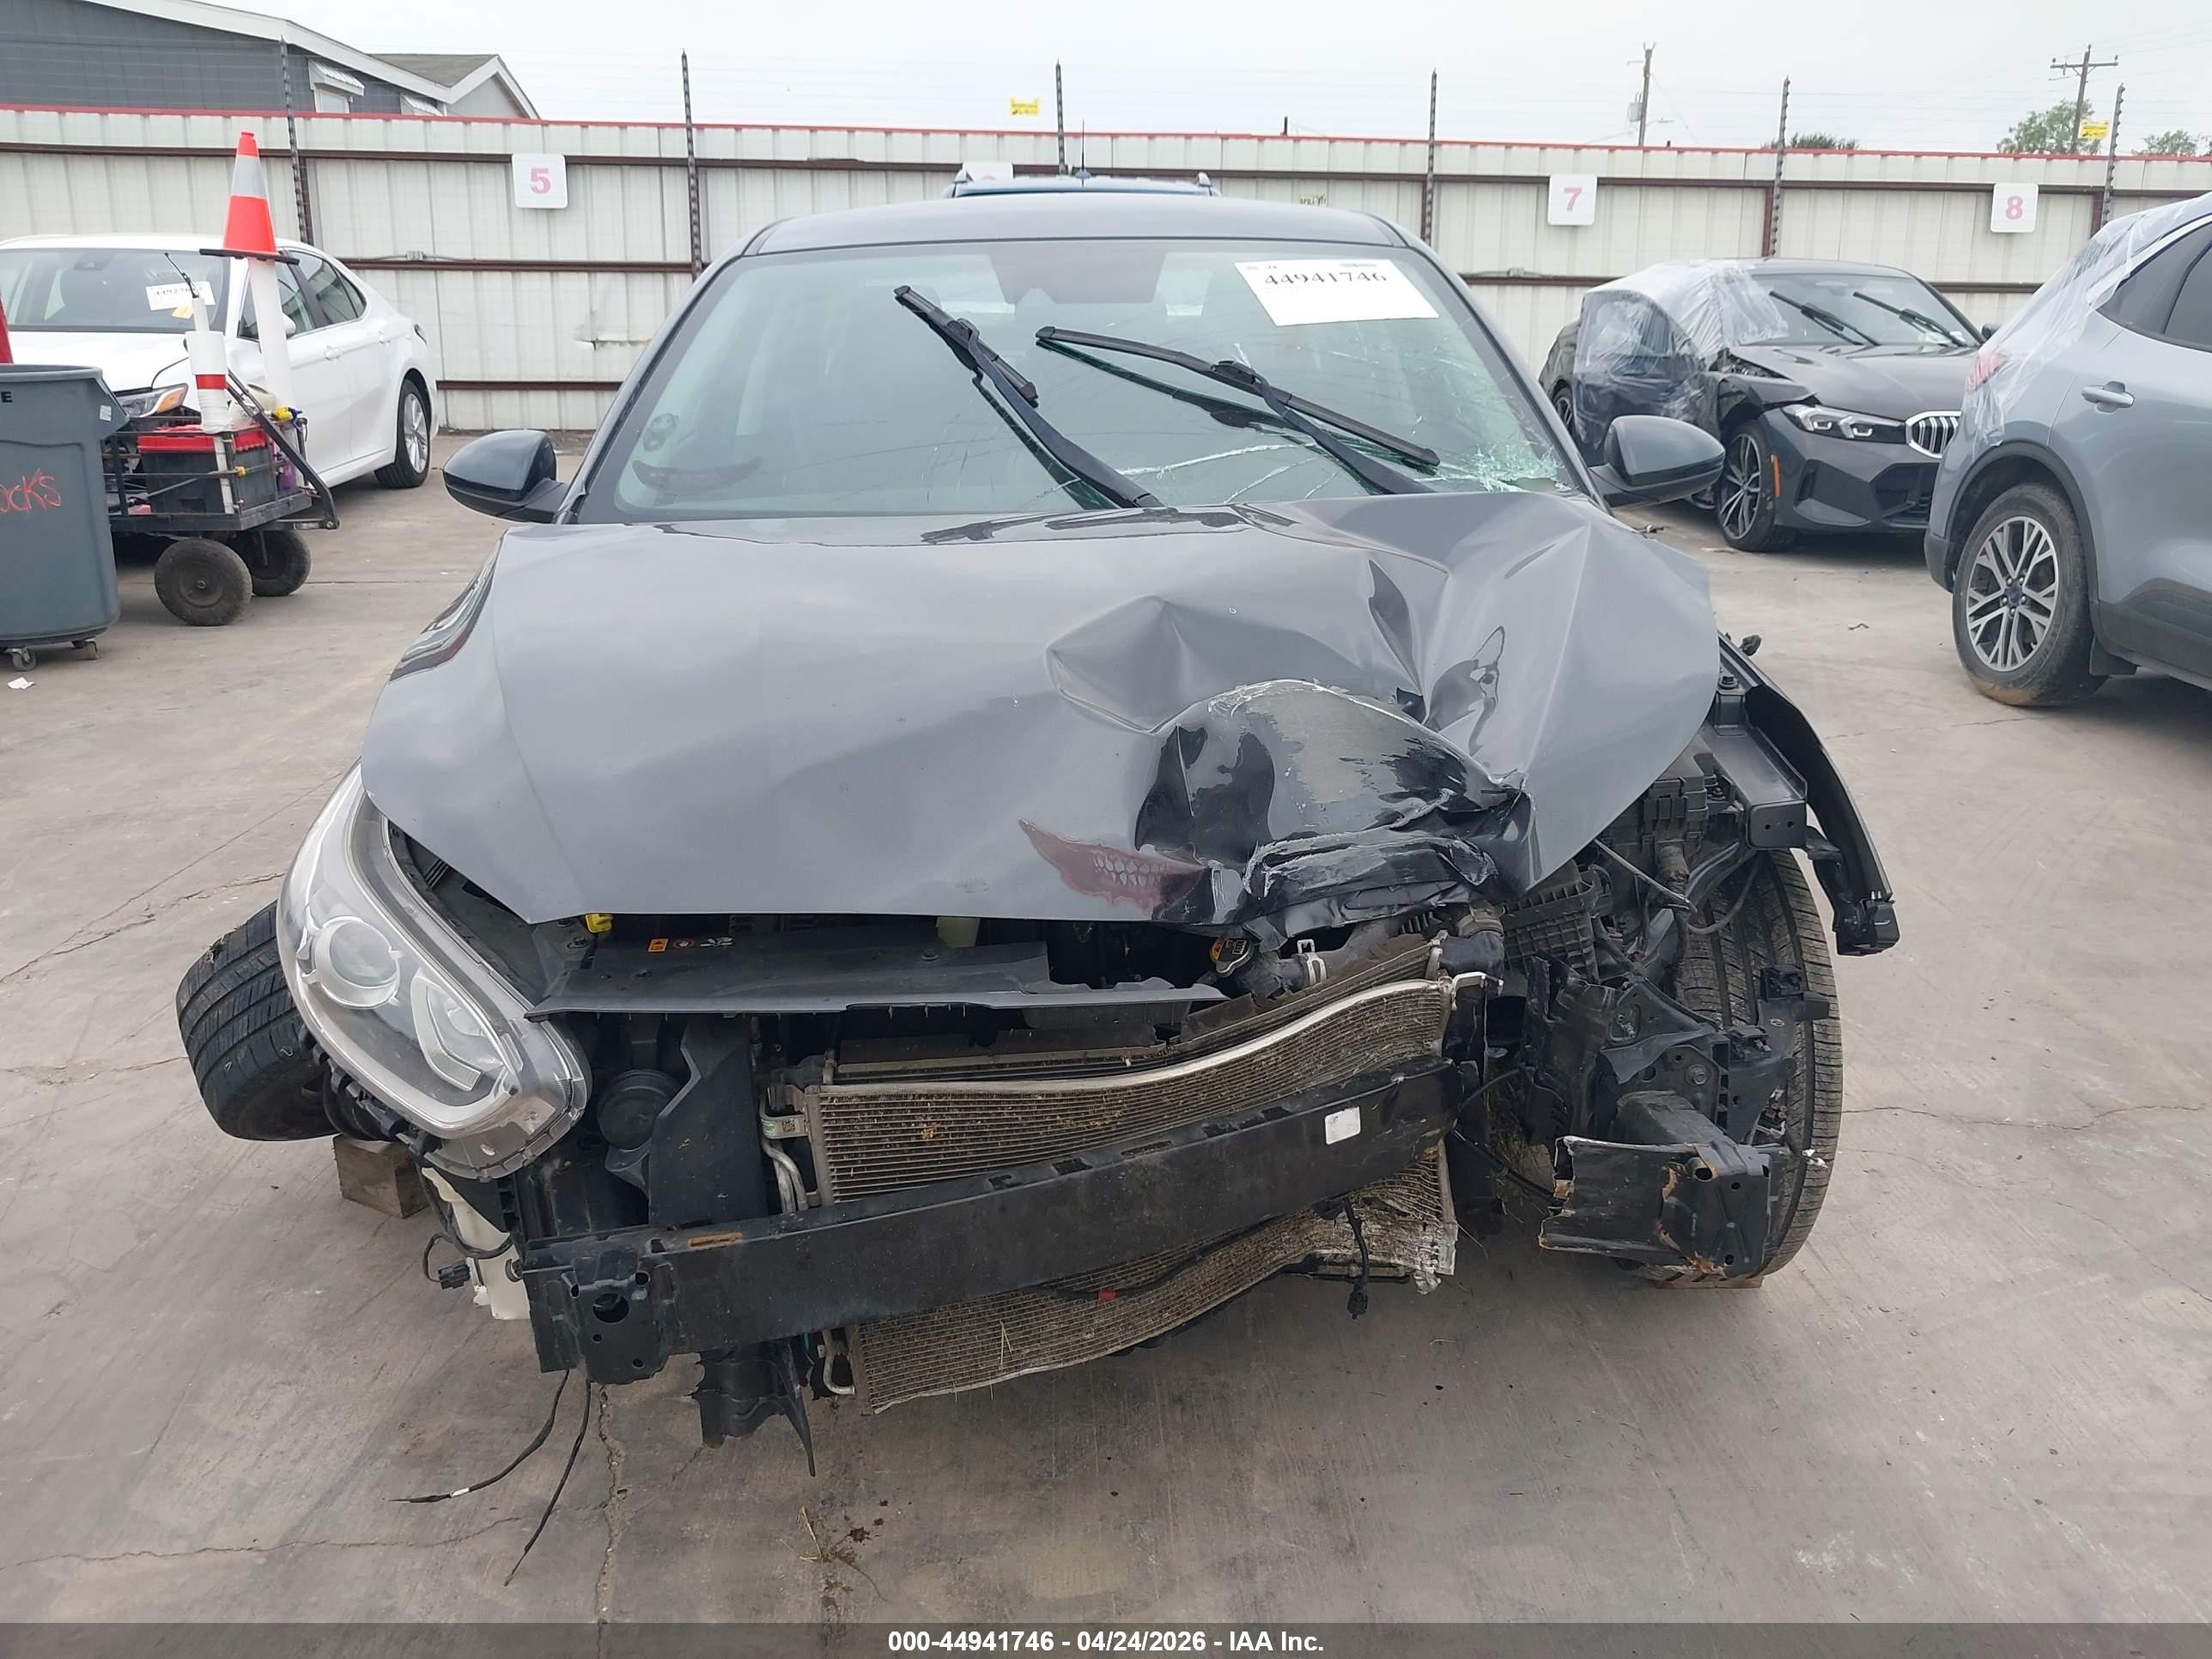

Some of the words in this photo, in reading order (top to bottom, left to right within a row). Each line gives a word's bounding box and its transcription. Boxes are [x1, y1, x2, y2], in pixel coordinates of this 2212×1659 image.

[531, 167, 550, 194] 5
[1564, 187, 1582, 211] 7
[2006, 196, 2023, 220] 8
